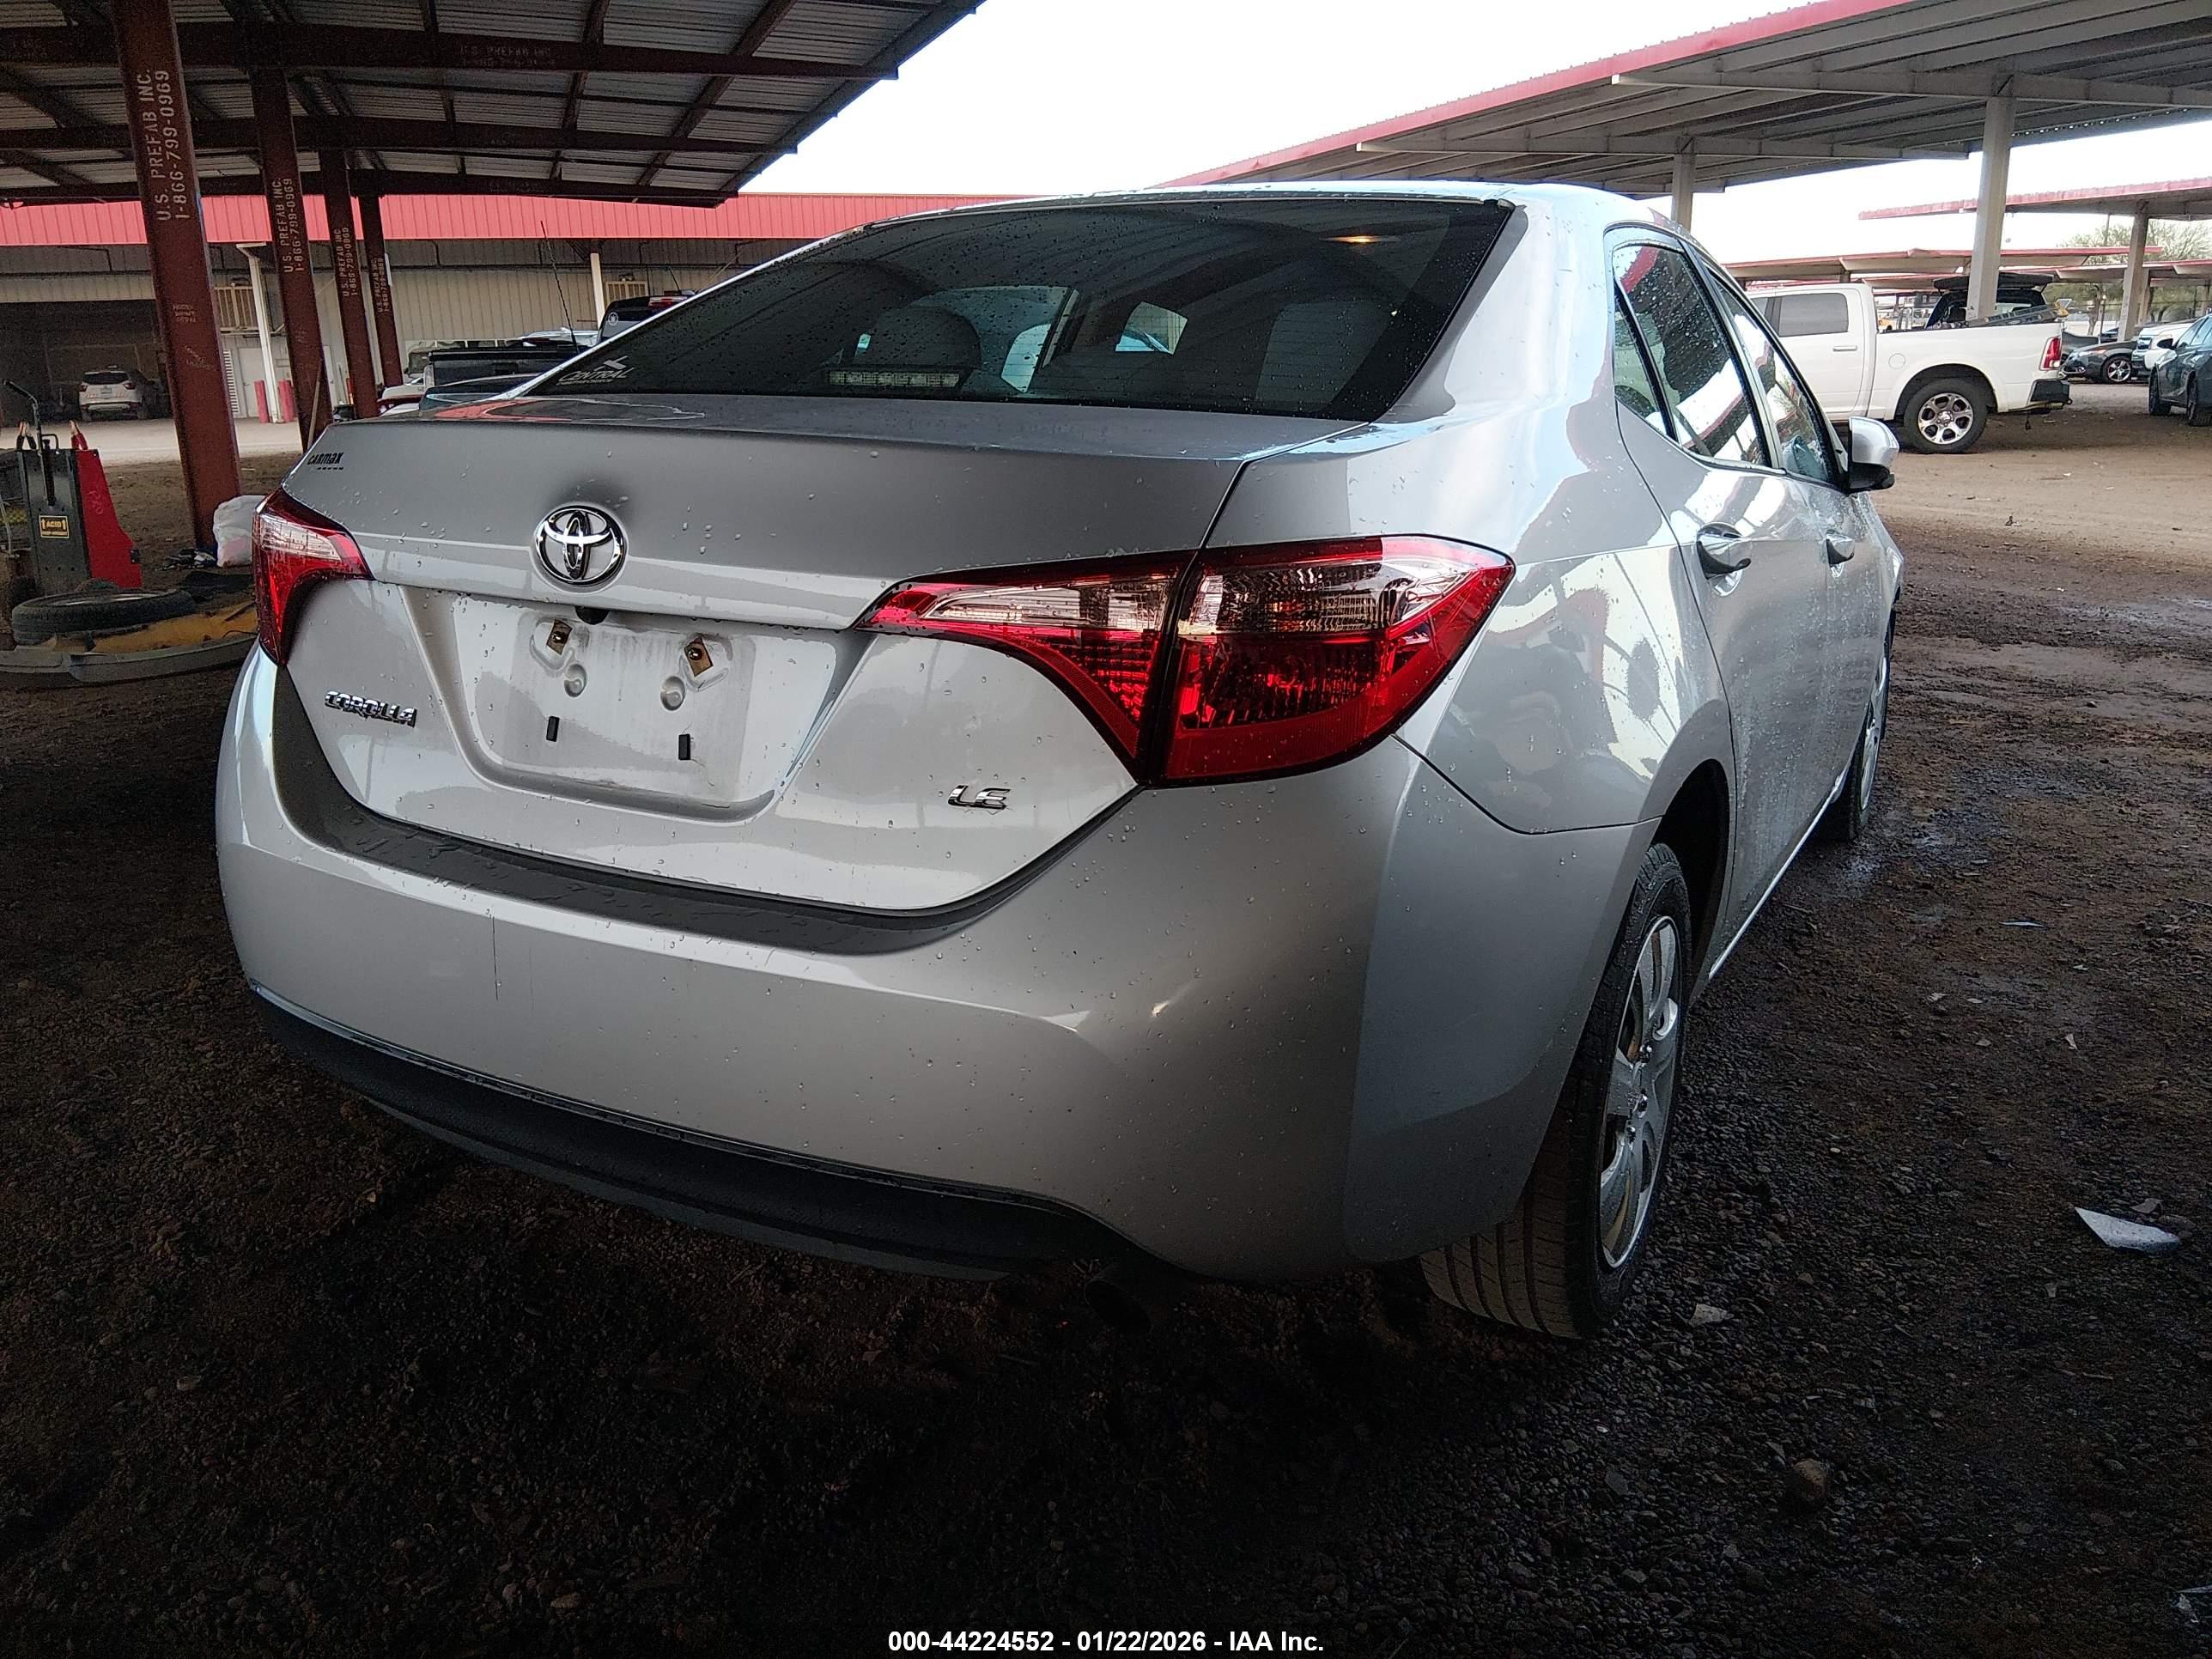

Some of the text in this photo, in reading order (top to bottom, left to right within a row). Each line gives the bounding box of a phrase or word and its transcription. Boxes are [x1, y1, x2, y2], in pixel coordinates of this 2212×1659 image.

[137, 70, 172, 221] U.S. PREFAB INC.
[155, 70, 191, 219] 1-866-799-0969
[275, 204, 290, 246] PREFAB
[283, 178, 305, 271] 1-866-799-0969
[283, 252, 294, 273] U.S.
[46, 520, 62, 529] ACID
[325, 690, 417, 728] COROLLA
[947, 784, 1012, 811] LE
